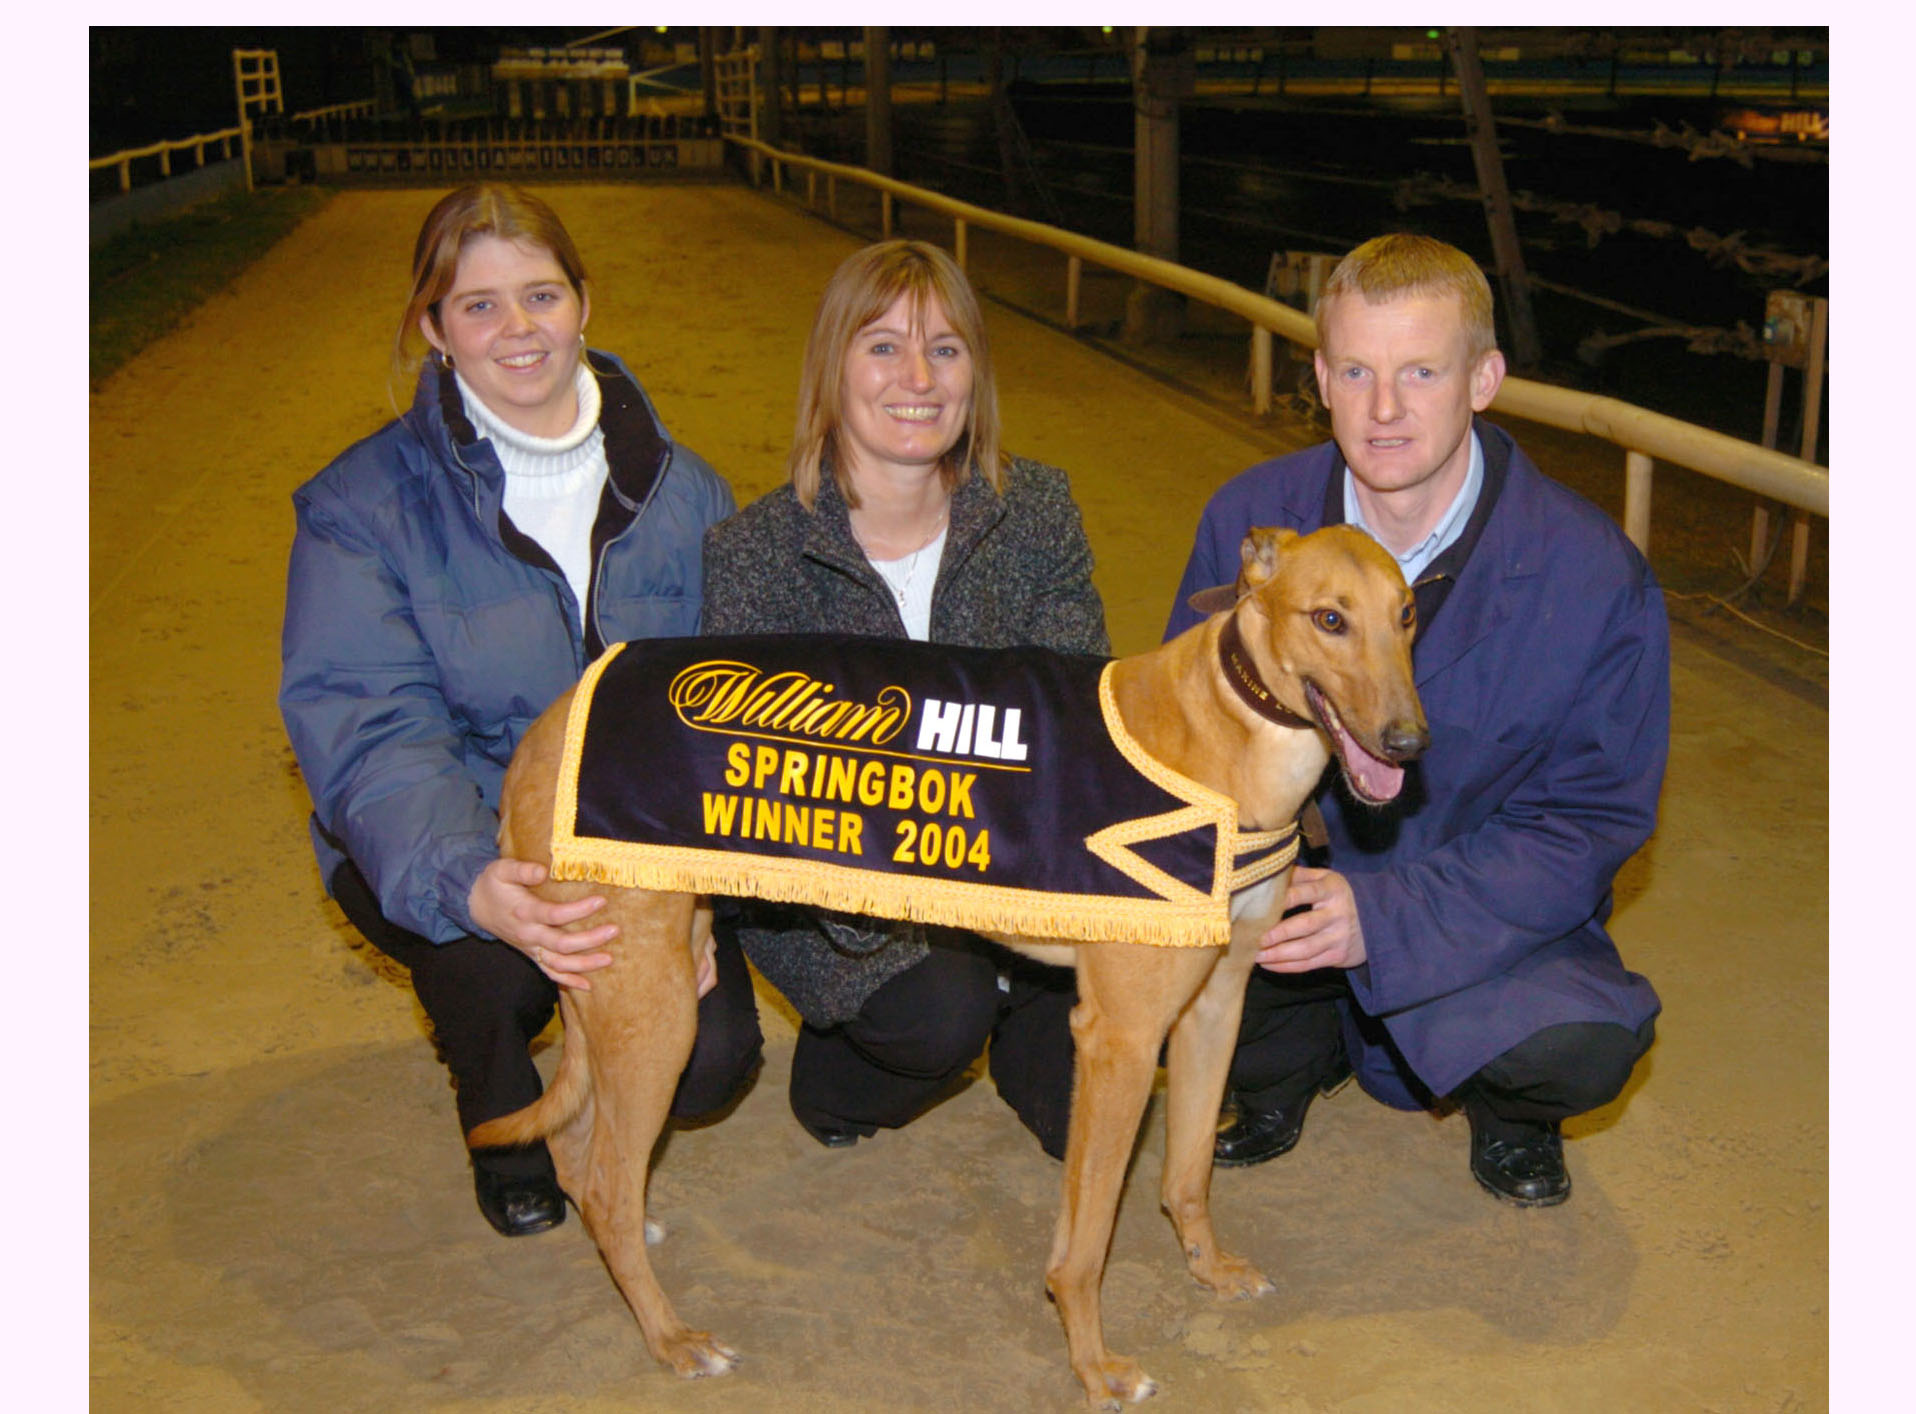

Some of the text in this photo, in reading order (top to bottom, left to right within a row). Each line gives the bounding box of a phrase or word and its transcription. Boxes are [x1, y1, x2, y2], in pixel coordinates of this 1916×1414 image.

[669, 660, 1028, 761] William HILL
[724, 741, 977, 818] SPRINGBOK
[702, 791, 991, 872] WINNER 2004
